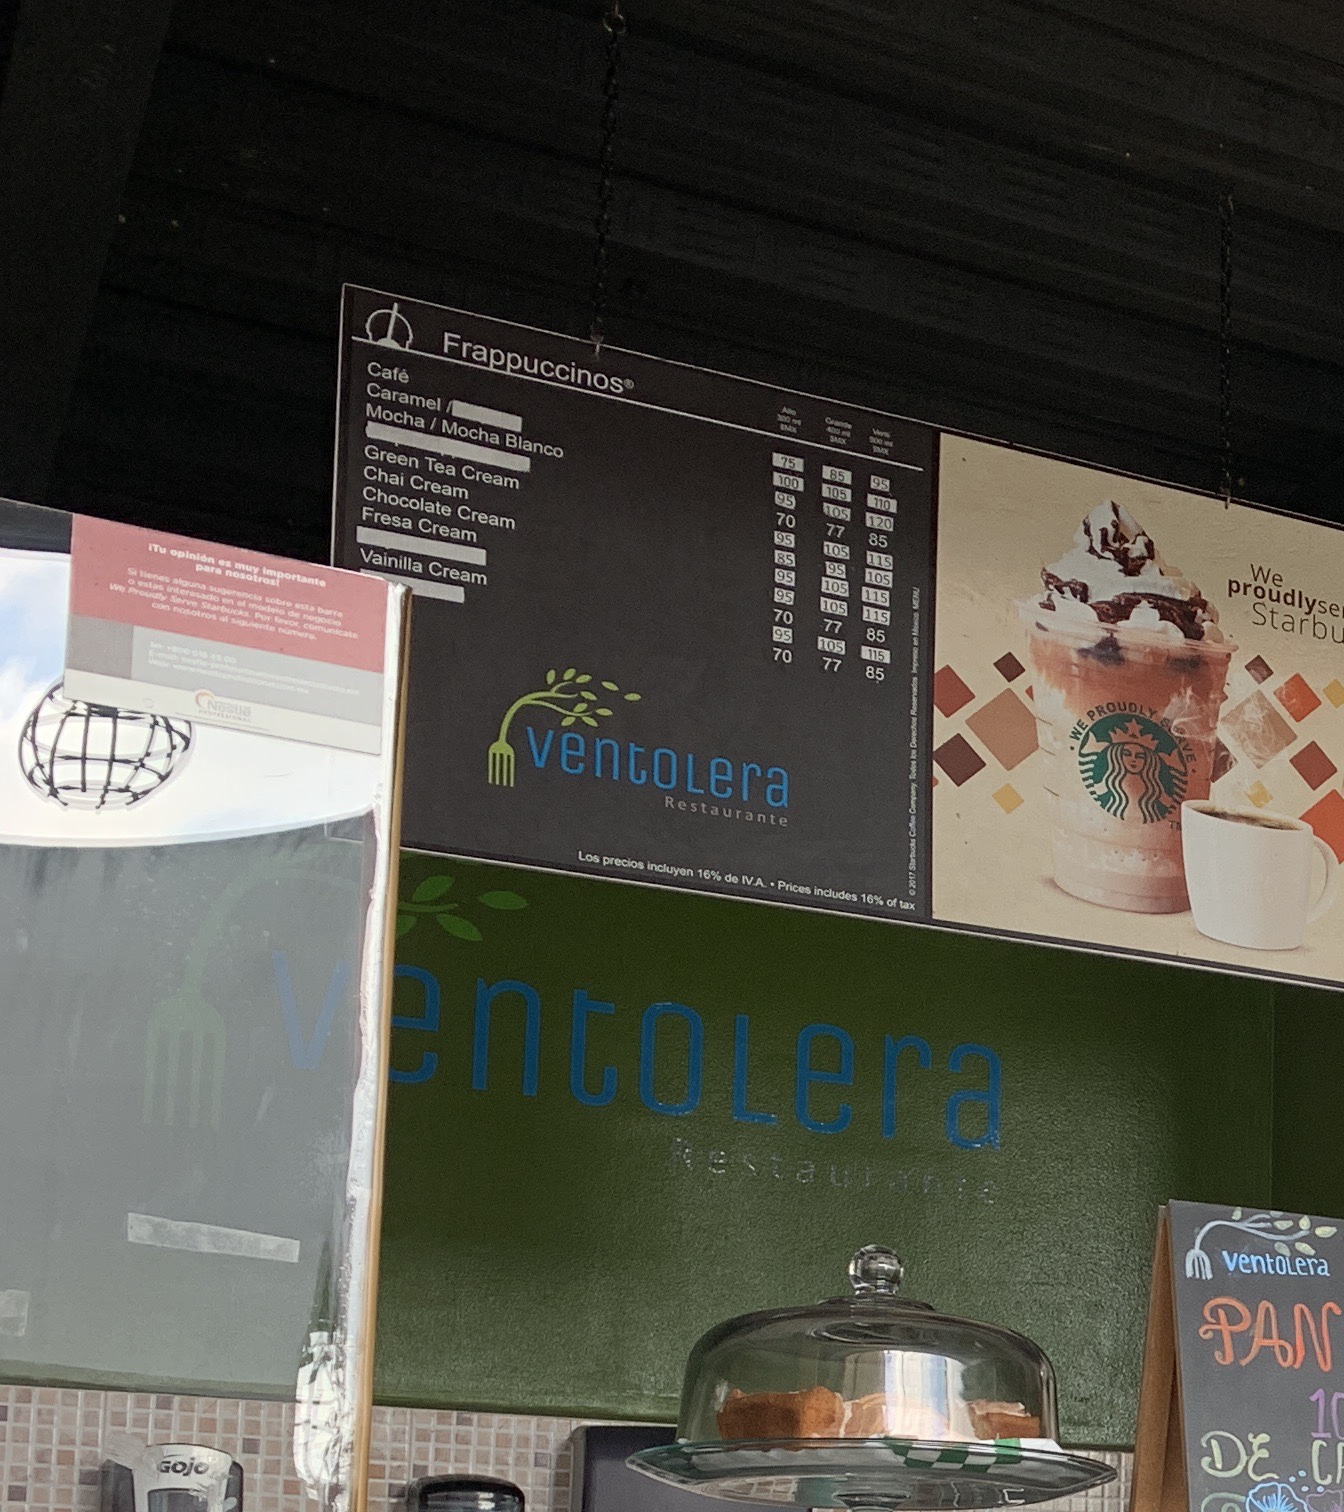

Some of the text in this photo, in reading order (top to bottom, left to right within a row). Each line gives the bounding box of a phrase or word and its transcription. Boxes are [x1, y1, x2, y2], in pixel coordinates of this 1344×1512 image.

[367, 361, 409, 384] Café
[367, 382, 442, 412] Caramel
[366, 402, 564, 459] Mocha Mocha Blanco
[363, 465, 469, 500] Chai Cream
[364, 444, 520, 490] Green Tea Cream
[780, 456, 889, 490] 75 85 95
[362, 486, 516, 530] Chocolate Cream
[778, 475, 891, 511] 100 105 110
[361, 506, 477, 543] Fresa Cream
[777, 493, 892, 530] 95 105 120
[775, 512, 888, 548] 70 77 85
[360, 547, 488, 586] Vainilla Cream
[776, 533, 892, 567] 95 105 115
[169, 548, 327, 588] opinión es muy importante
[195, 563, 222, 575] para
[777, 552, 891, 585] 85 95 105
[1250, 563, 1284, 587] We
[776, 570, 888, 604] 95 105 115
[776, 589, 889, 624] 95 105 115
[773, 608, 886, 643] 70 77 85
[774, 629, 885, 661] 95 105 115
[772, 647, 885, 681] 70 77 85
[1069, 719, 1089, 741] WE
[1086, 701, 1158, 721] PROUDLY
[664, 795, 789, 827] Restaurante
[578, 851, 600, 863] Los
[603, 856, 645, 870] precios
[647, 860, 694, 877] incluyen
[697, 868, 722, 882] 16%
[724, 874, 739, 884] de
[777, 880, 812, 895] Prices
[813, 886, 858, 902] includes
[860, 893, 884, 906] 16%
[886, 898, 897, 907] of
[899, 900, 916, 910] tax
[1198, 1296, 1342, 1373] PAN
[1200, 1430, 1279, 1481] DE
